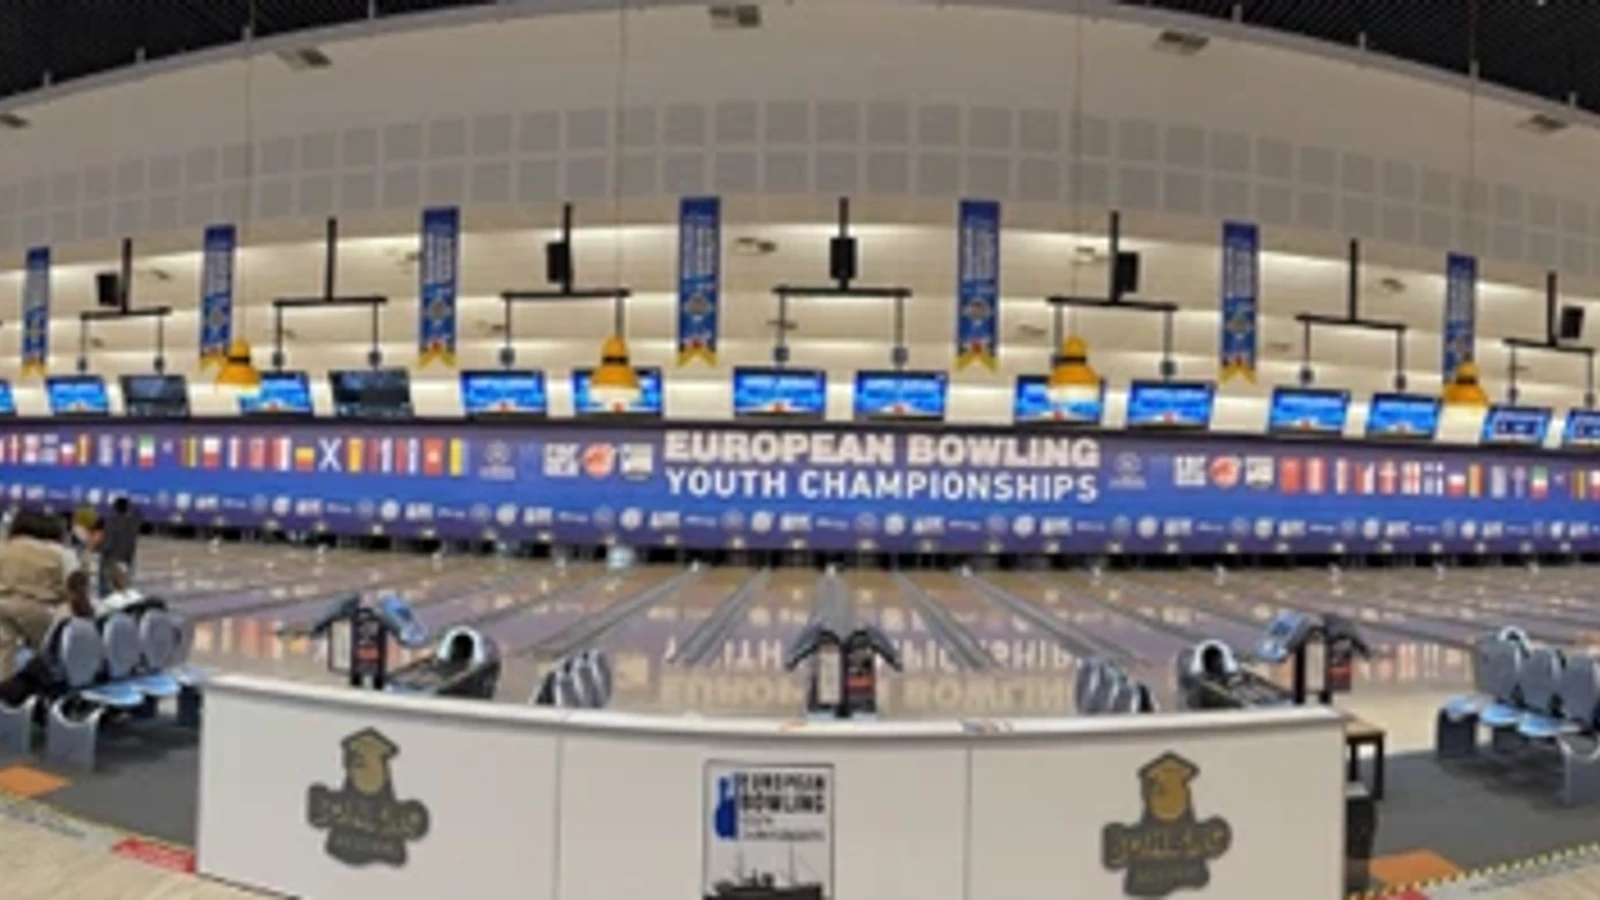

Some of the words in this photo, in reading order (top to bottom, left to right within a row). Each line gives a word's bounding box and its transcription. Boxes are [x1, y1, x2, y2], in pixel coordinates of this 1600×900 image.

[664, 430, 895, 465] EUROPEAN
[906, 434, 1099, 468] BOWLING
[665, 466, 787, 498] YOUTH
[798, 469, 1099, 503] CHAMPIONSHIPS
[740, 793, 825, 814] BOWLING
